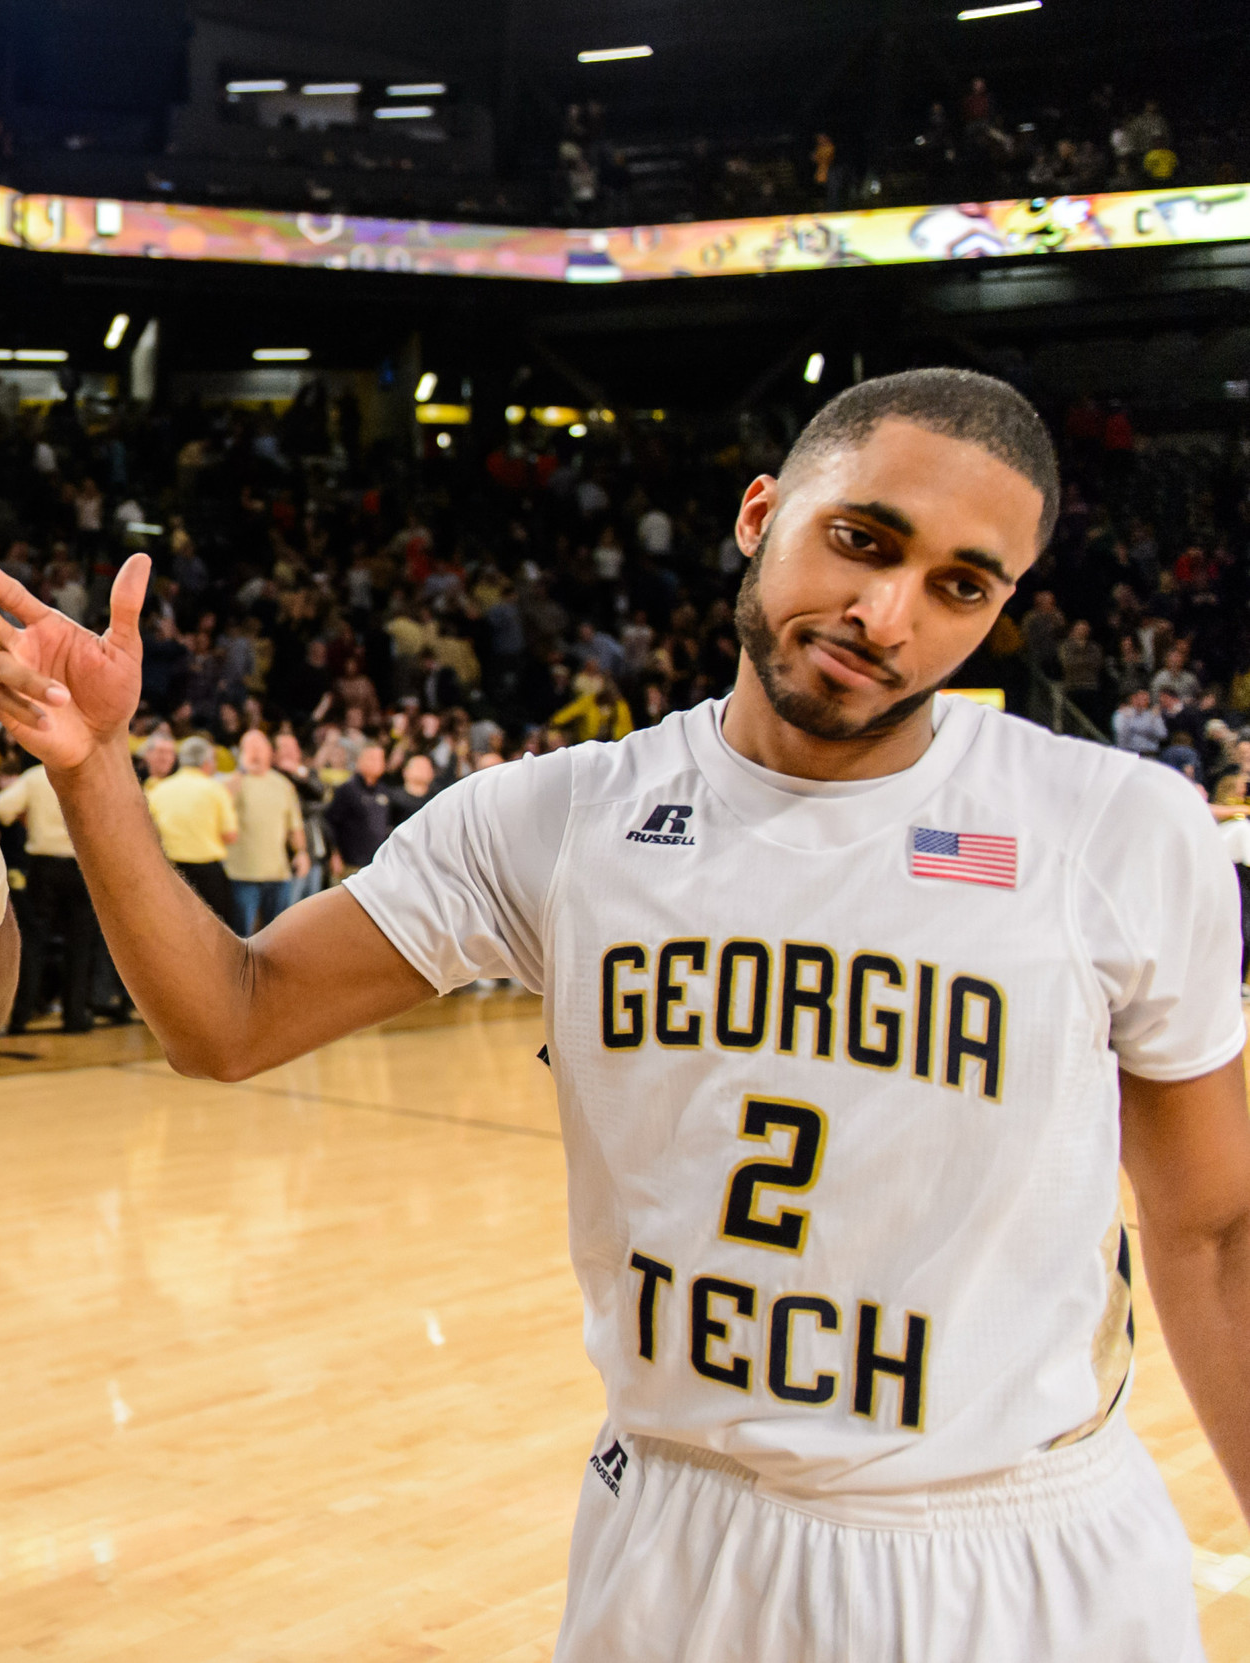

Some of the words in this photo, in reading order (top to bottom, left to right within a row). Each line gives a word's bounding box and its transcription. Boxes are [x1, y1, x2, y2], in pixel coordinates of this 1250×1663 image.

[626, 830, 695, 845] RUSSELL
[641, 804, 693, 834] R
[601, 937, 1008, 1105] GEORGIA
[719, 1093, 829, 1257] 2
[626, 1250, 930, 1433] TECH
[589, 1454, 620, 1499] RUSSEL
